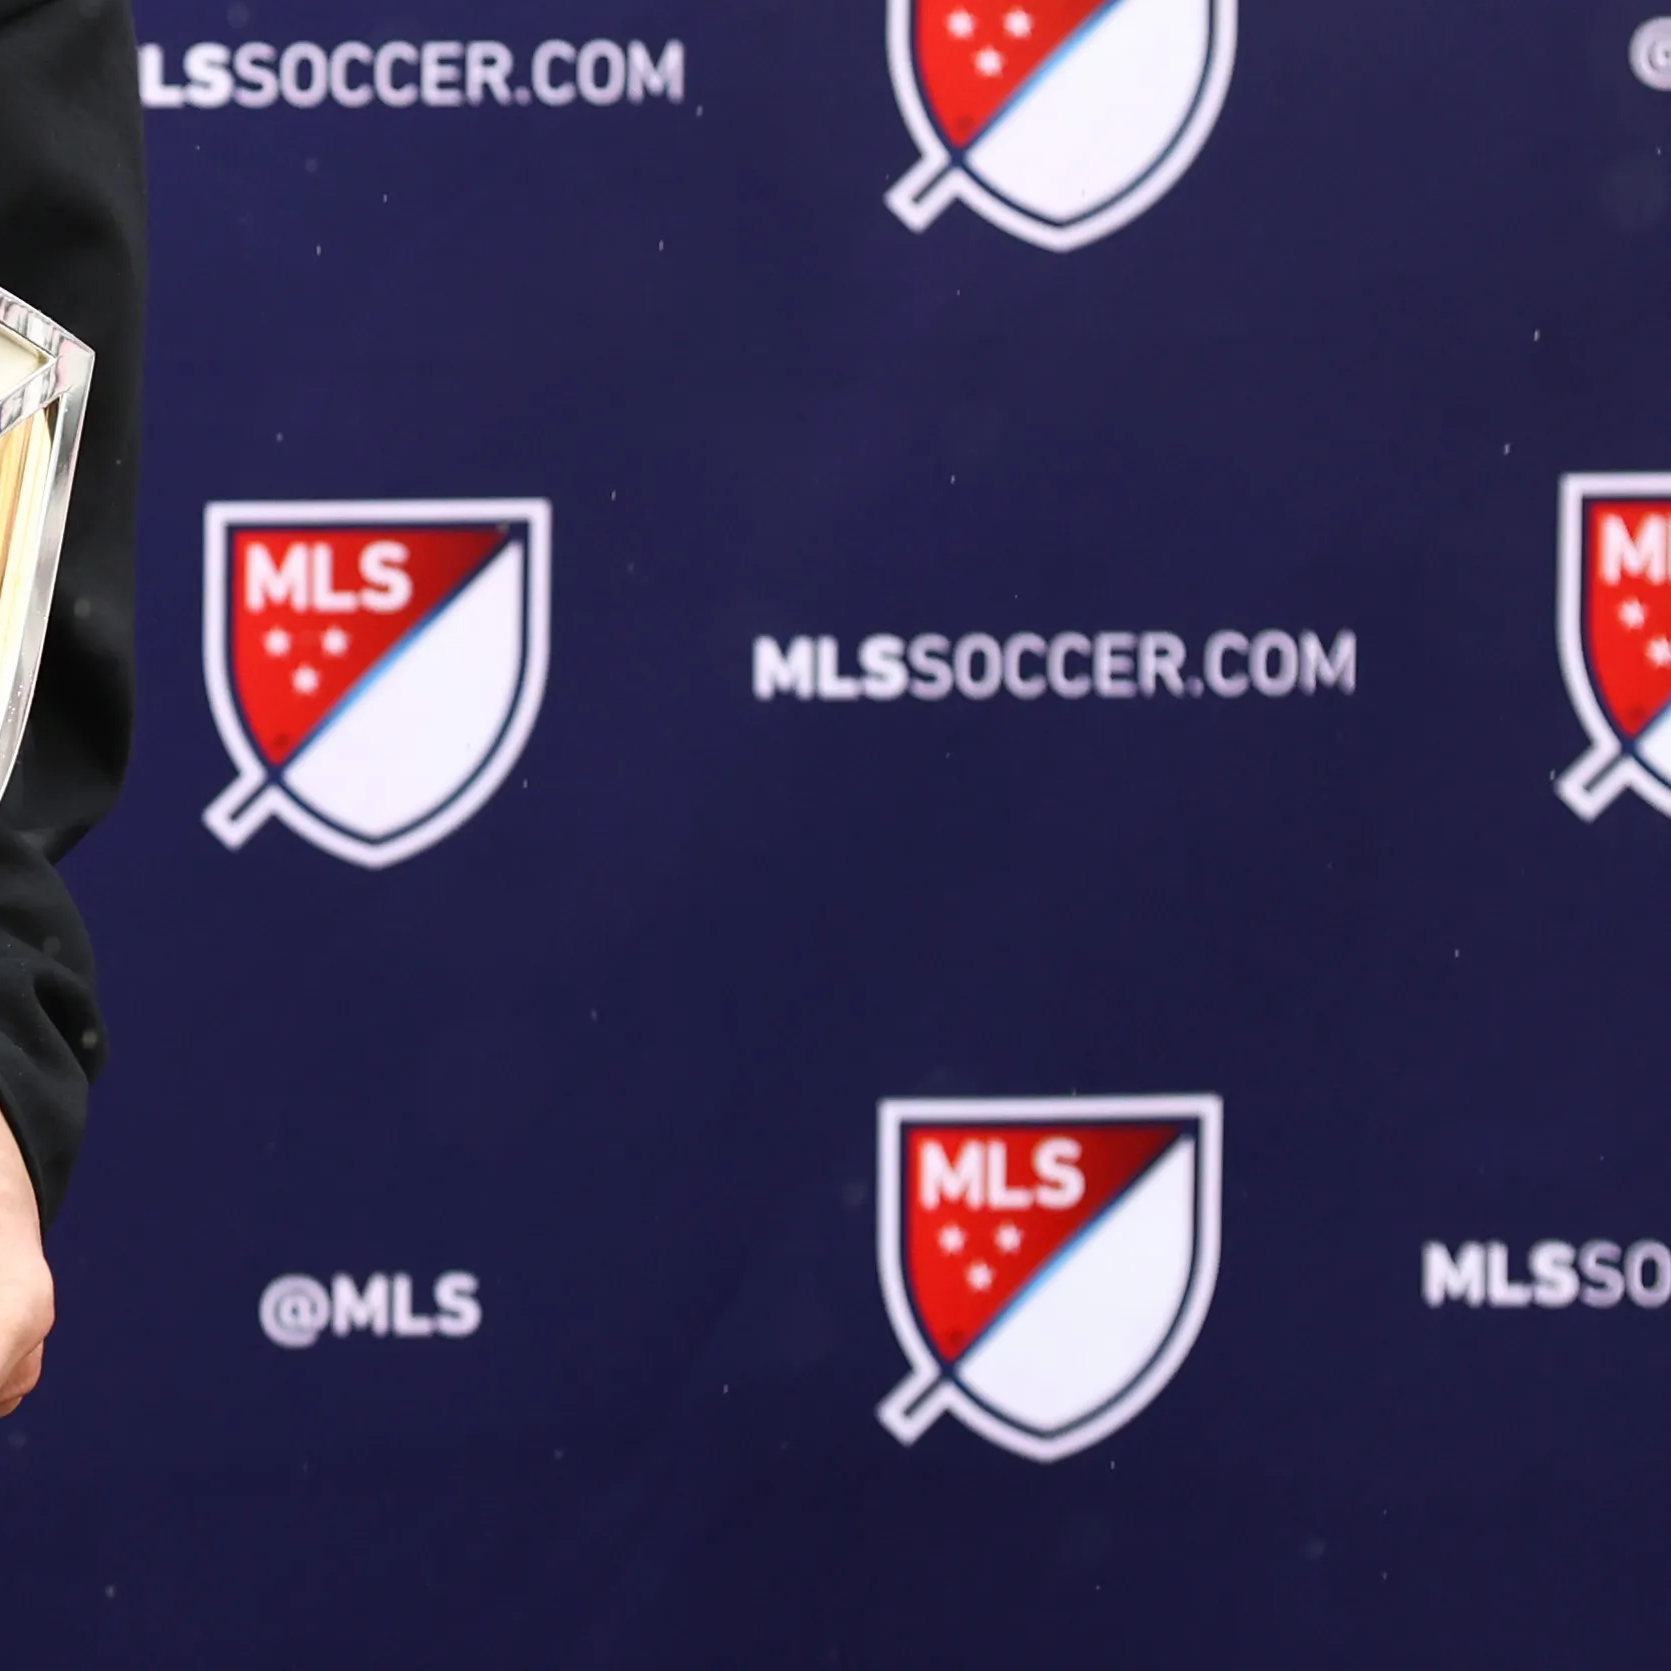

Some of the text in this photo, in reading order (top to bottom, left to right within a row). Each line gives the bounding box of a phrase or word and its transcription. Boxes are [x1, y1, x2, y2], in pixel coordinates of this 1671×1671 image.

[136, 38, 685, 109] LSSOCCER.COM
[244, 539, 413, 613] MLS
[752, 630, 1357, 700] MLSSOCCER.COM
[919, 1137, 1086, 1210] MLS
[259, 1271, 482, 1347] @MLS
